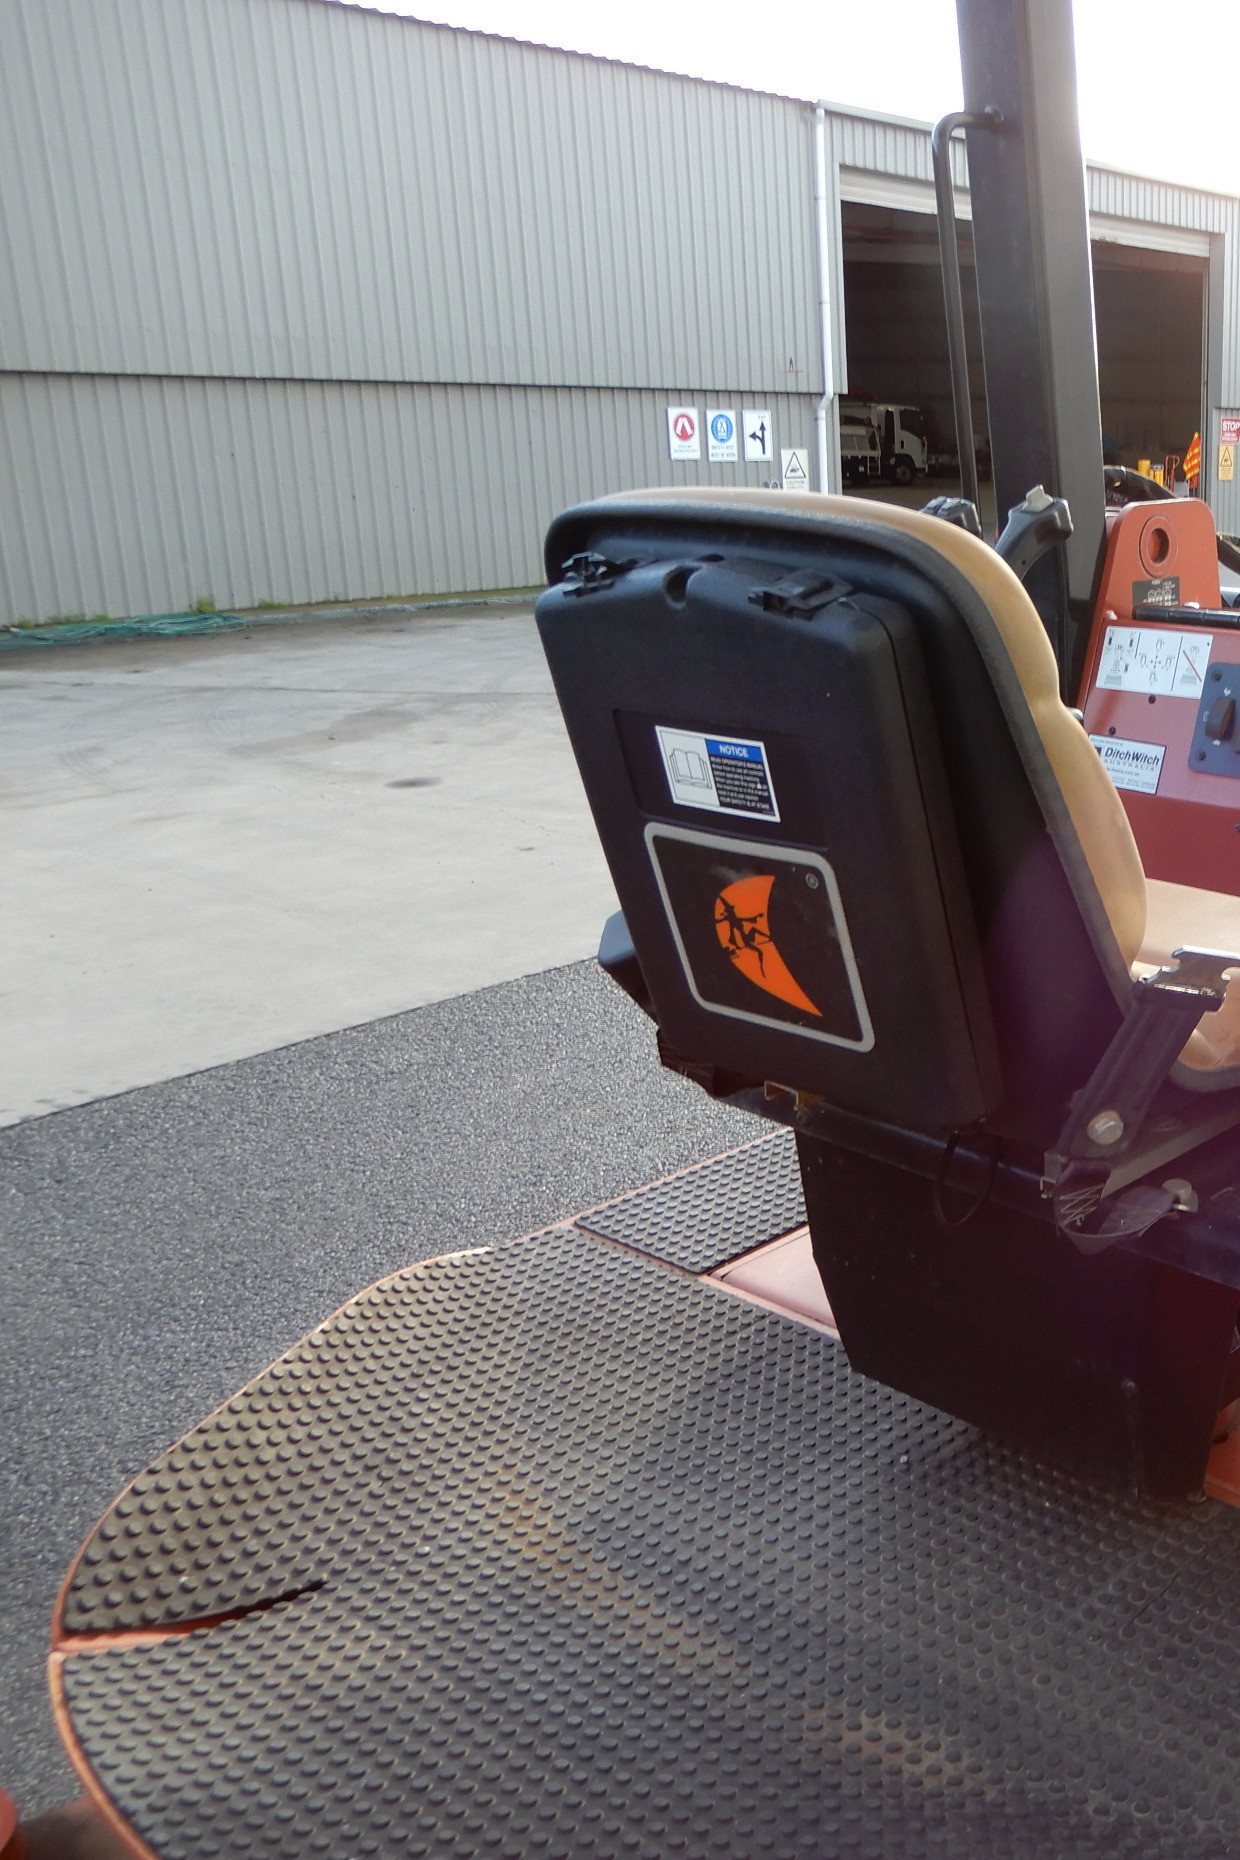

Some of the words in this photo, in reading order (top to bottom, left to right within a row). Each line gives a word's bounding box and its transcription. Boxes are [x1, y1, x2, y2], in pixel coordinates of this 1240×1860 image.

[1222, 420, 1240, 432] STOP
[719, 744, 749, 758] NOTICE
[1105, 747, 1160, 766] DitchWitch
[1104, 759, 1155, 772] AUSTRALIA
